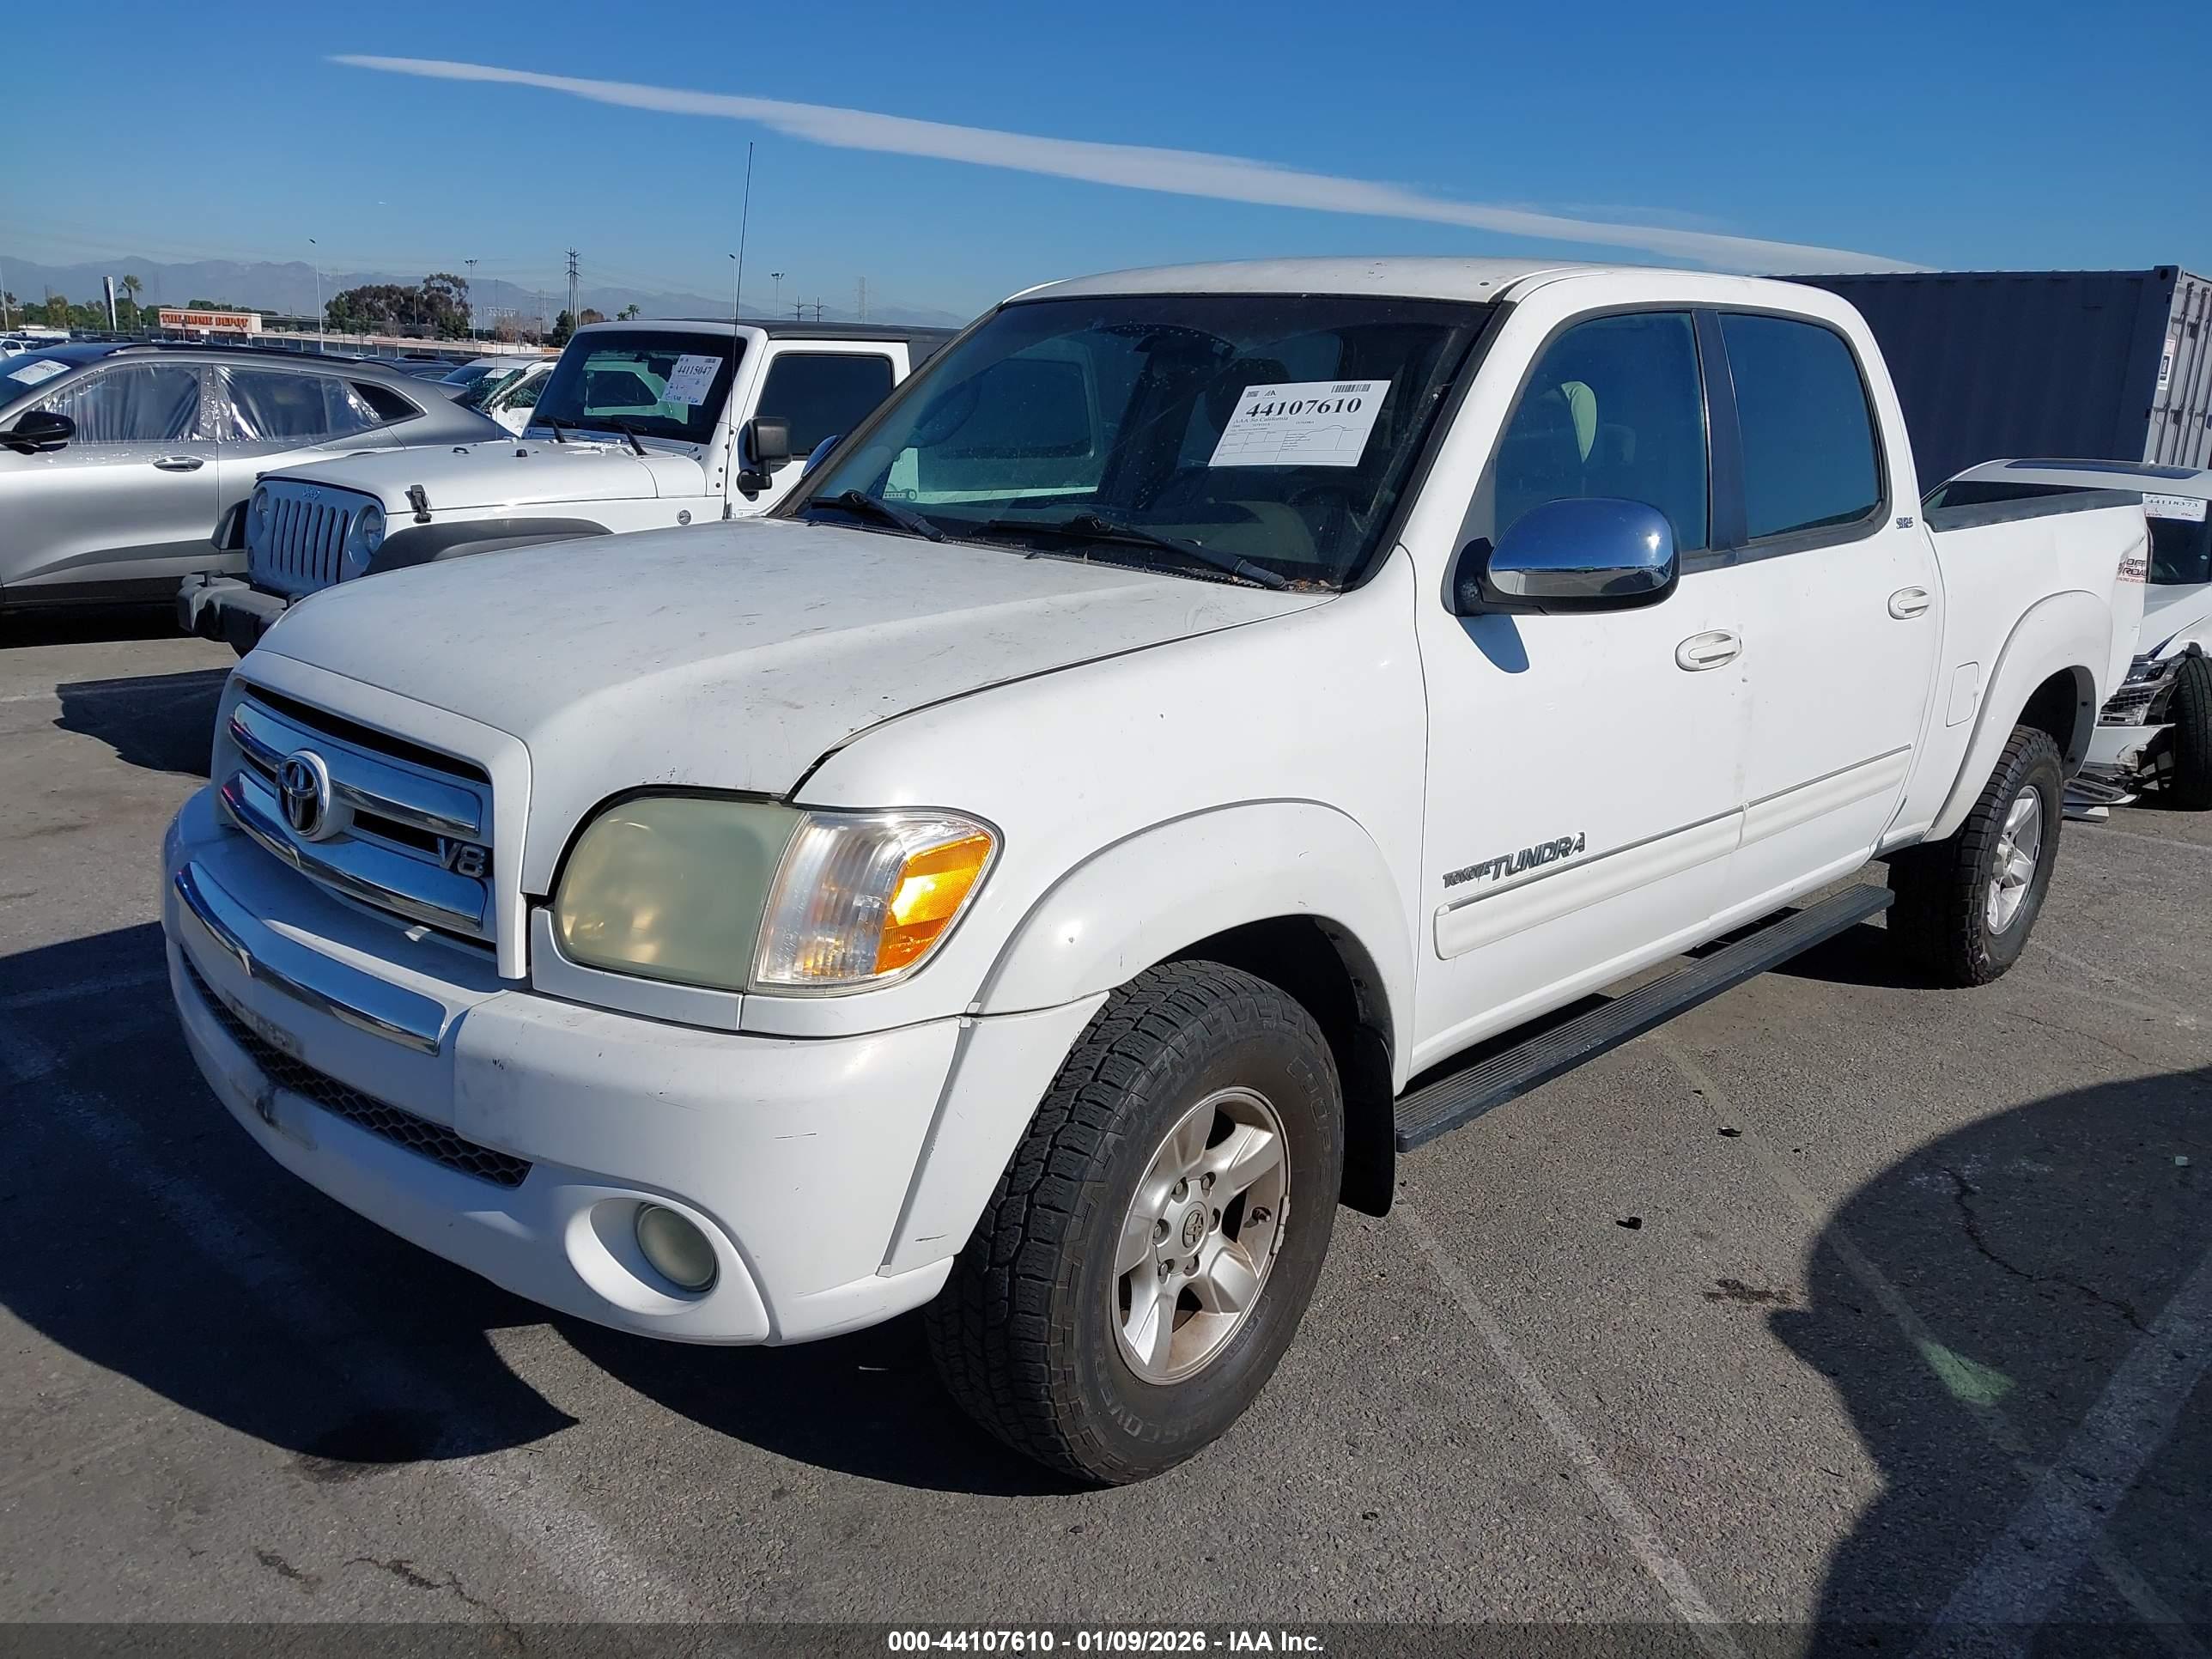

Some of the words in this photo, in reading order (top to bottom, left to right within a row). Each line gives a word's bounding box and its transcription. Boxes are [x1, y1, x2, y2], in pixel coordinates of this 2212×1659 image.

[216, 317, 248, 327] DEPOT
[1246, 398, 1362, 417] 44107610
[437, 836, 486, 878] V8
[1443, 860, 1492, 889] TOYOTA
[1492, 831, 1586, 881] TUNDRA
